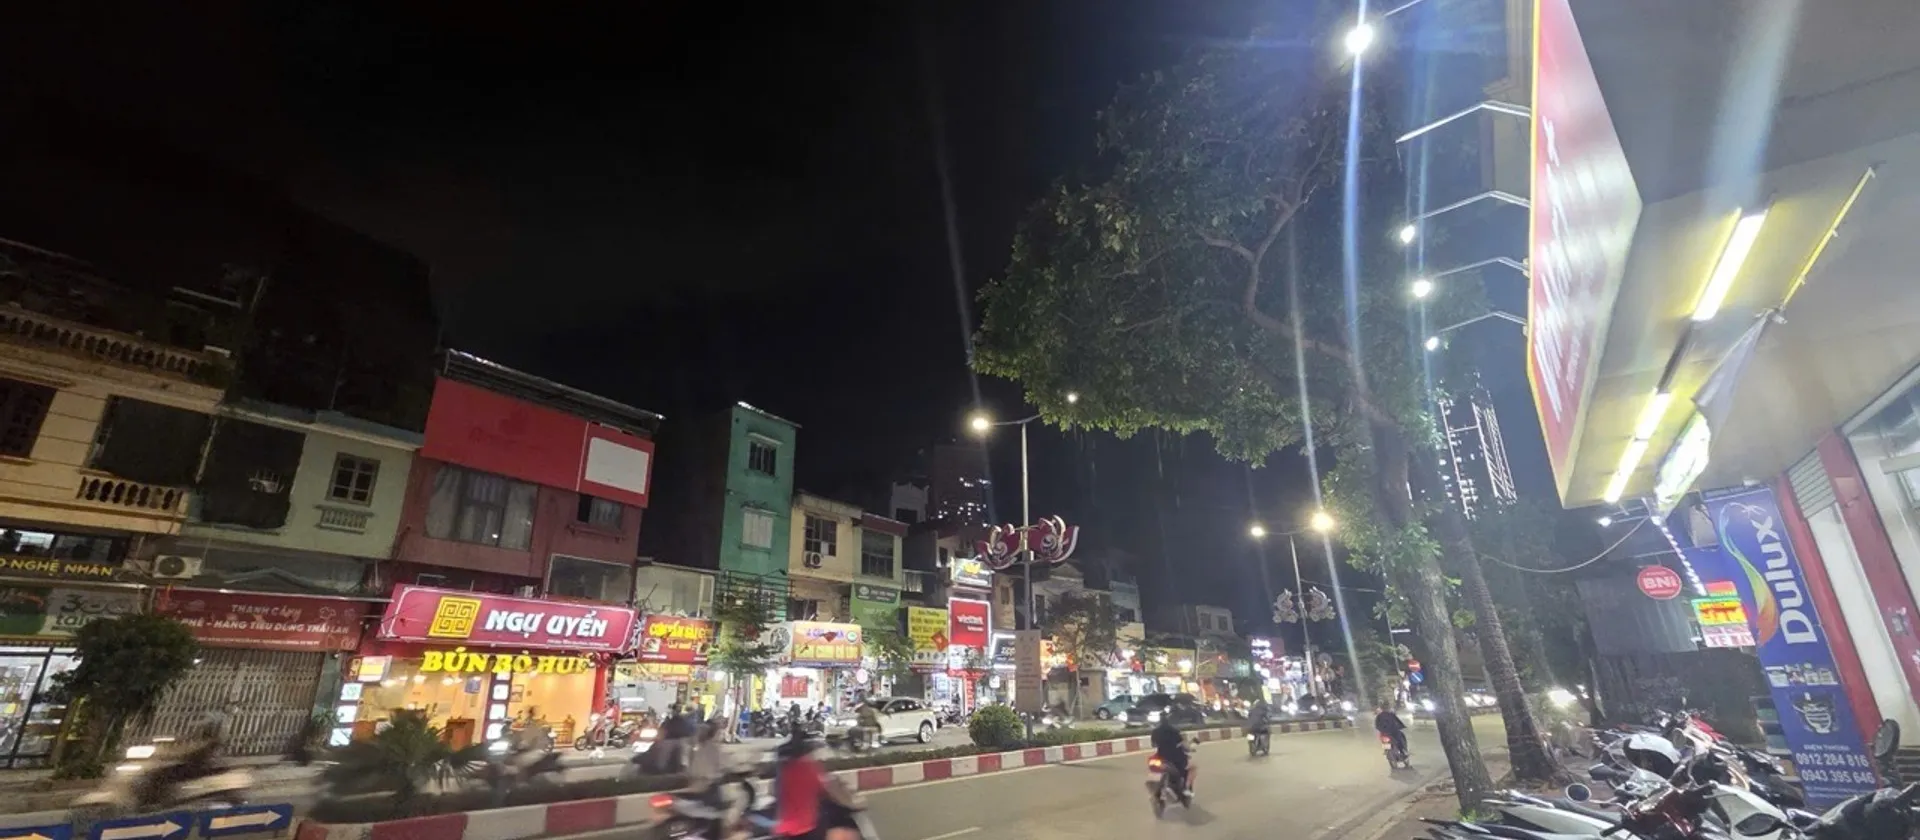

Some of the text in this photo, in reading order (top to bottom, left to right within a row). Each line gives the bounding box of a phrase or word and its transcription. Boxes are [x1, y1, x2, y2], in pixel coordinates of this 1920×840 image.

[1751, 516, 1818, 645] Dulux
[485, 609, 609, 638] NGỰ UYỂN
[420, 647, 490, 673] BÚN
[492, 650, 532, 673] BÒ
